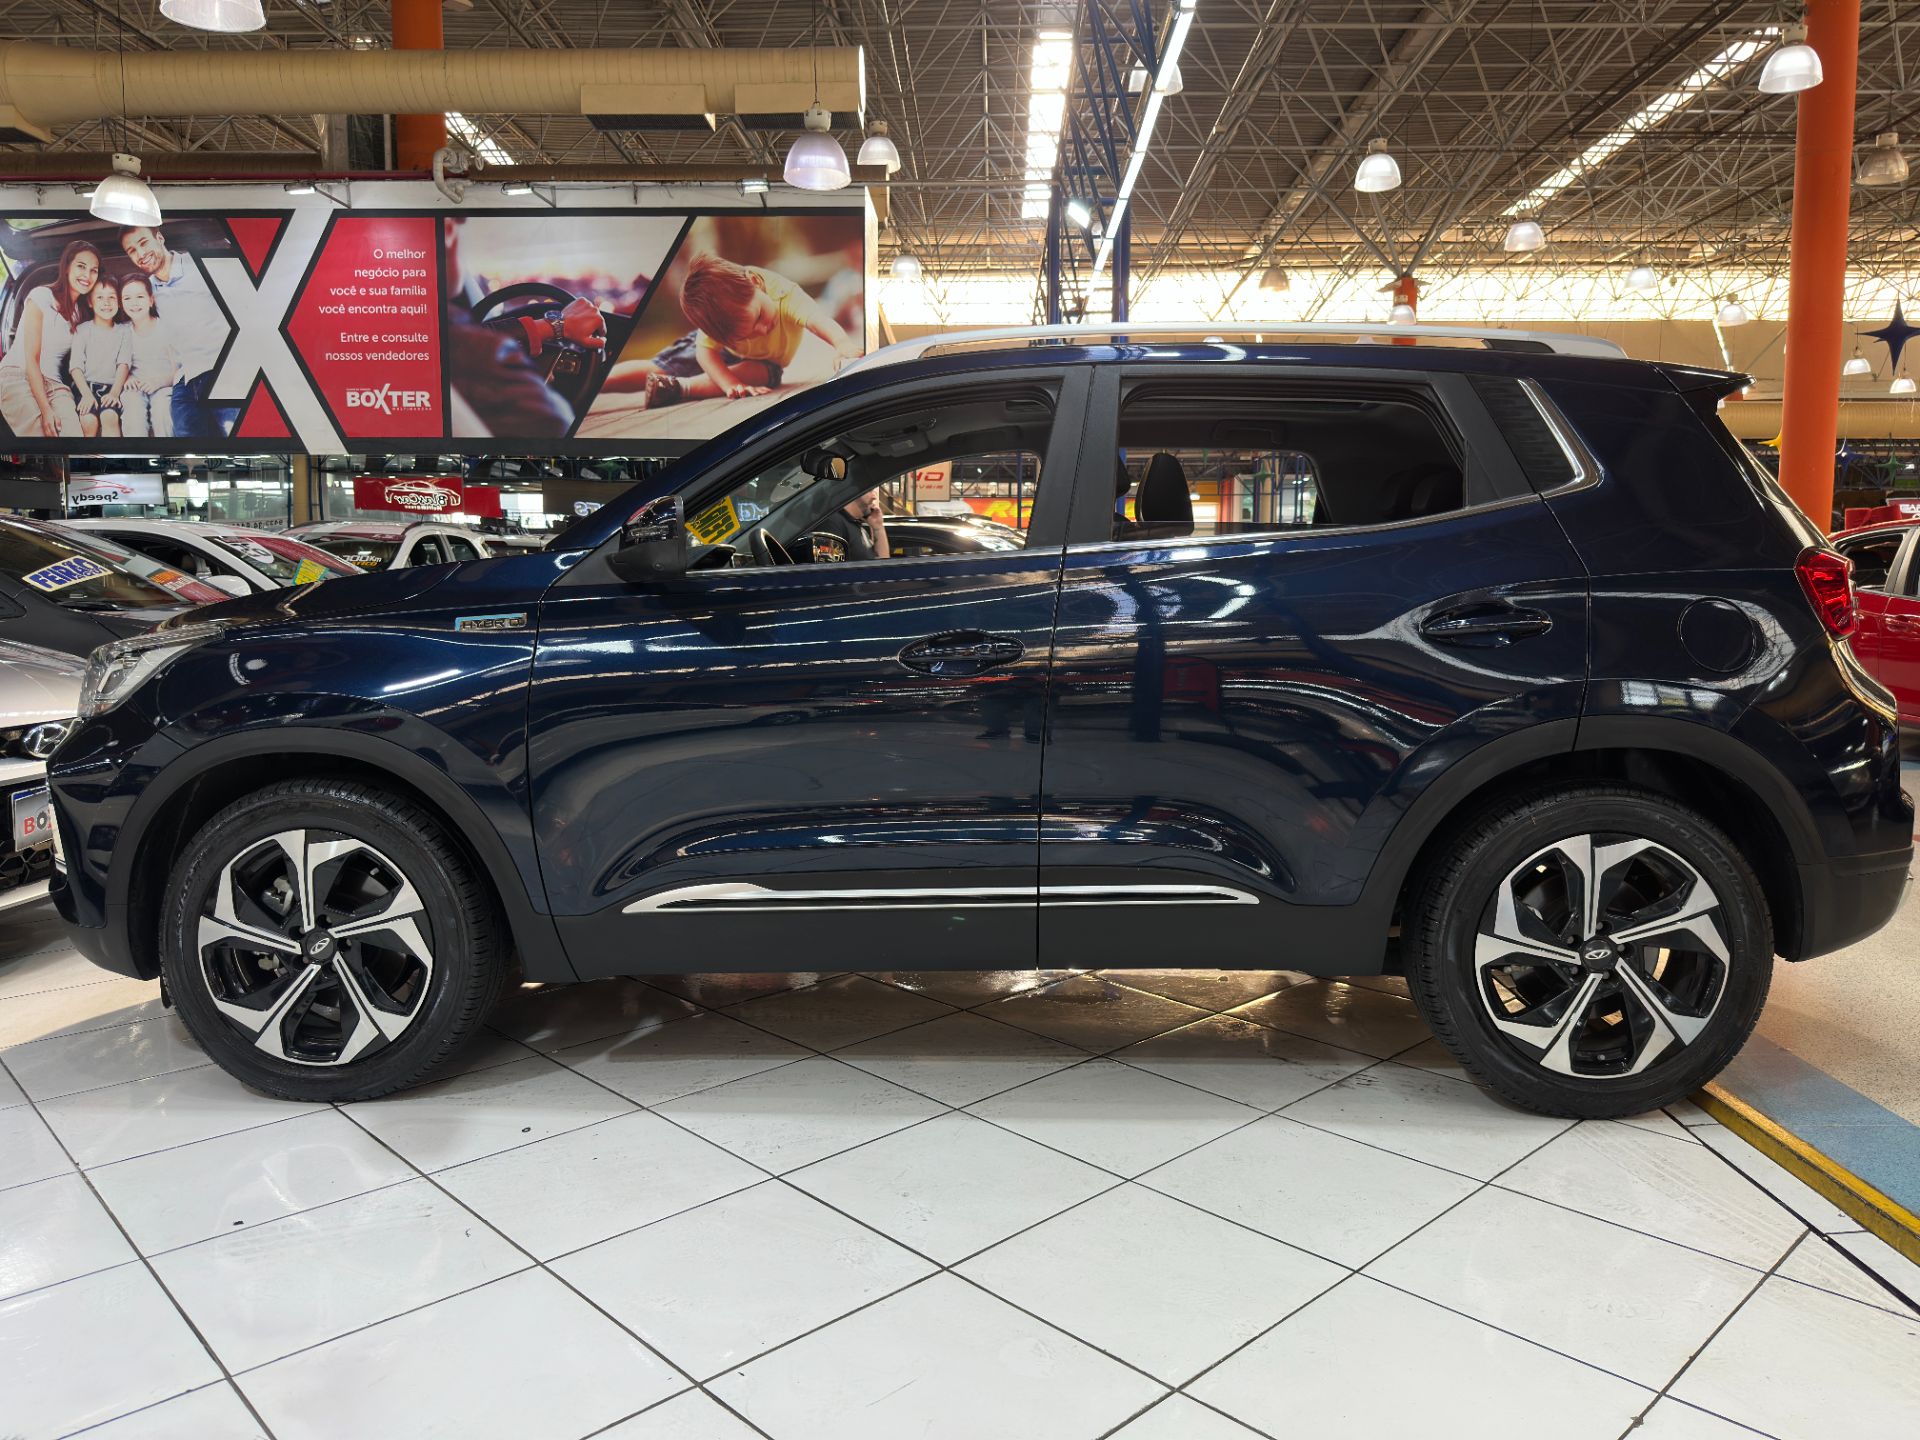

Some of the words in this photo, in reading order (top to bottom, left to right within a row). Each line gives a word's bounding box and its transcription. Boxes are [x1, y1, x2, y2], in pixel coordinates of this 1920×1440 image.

[373, 248, 384, 260] O
[386, 248, 427, 260] melhor
[354, 267, 400, 280] negócio
[402, 269, 427, 280] para
[329, 285, 357, 296] você
[359, 287, 366, 296] e
[369, 287, 388, 296] sua
[390, 285, 427, 296] família
[318, 304, 346, 314] você
[348, 304, 398, 314] encontra
[400, 304, 428, 316] aqui!
[340, 332, 370, 343] Entre
[372, 334, 379, 343] e
[381, 332, 429, 343] consulte
[325, 352, 363, 361] nossos
[365, 350, 430, 361] vendedores
[346, 383, 432, 415] BOXTER
[23, 811, 53, 837] BO
